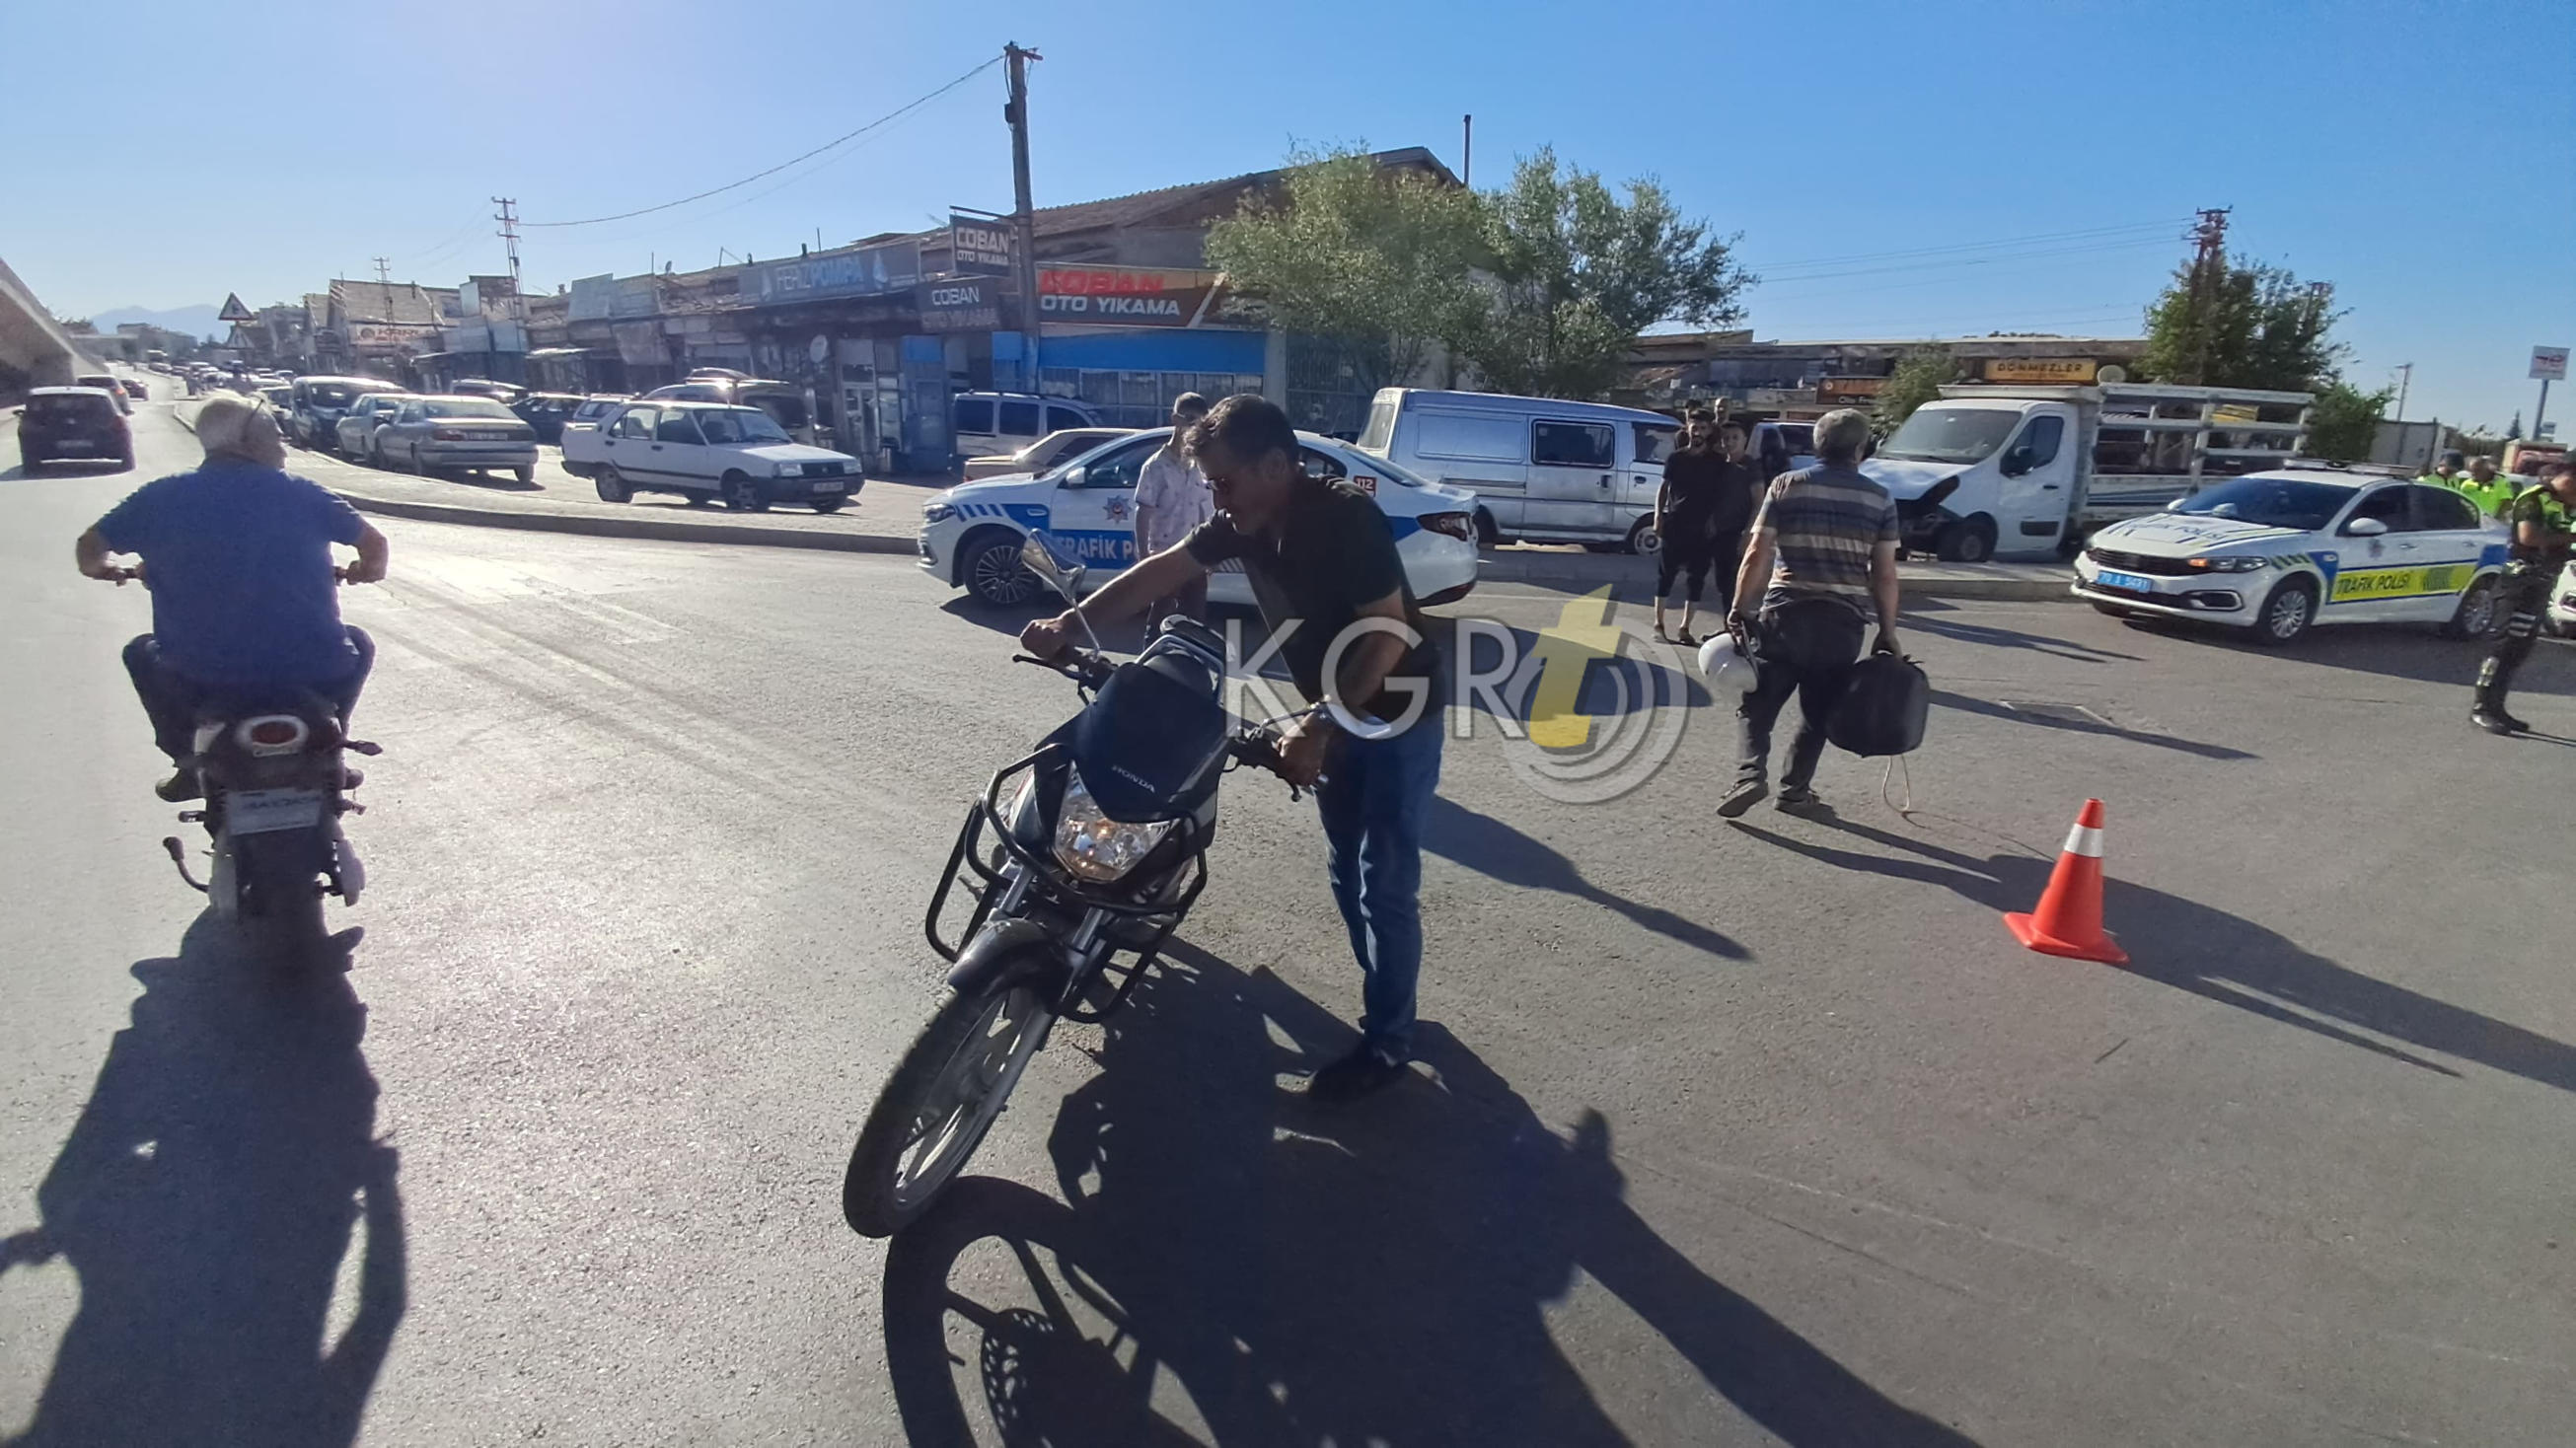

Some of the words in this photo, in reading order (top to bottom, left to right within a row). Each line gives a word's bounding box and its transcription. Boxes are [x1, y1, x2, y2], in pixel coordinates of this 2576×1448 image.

[957, 250, 975, 262] OTO
[1040, 295, 1087, 312] OTO
[1096, 297, 1181, 317] YIKAMA
[1357, 477, 1374, 490] 112
[1112, 764, 1155, 793] HONDA
